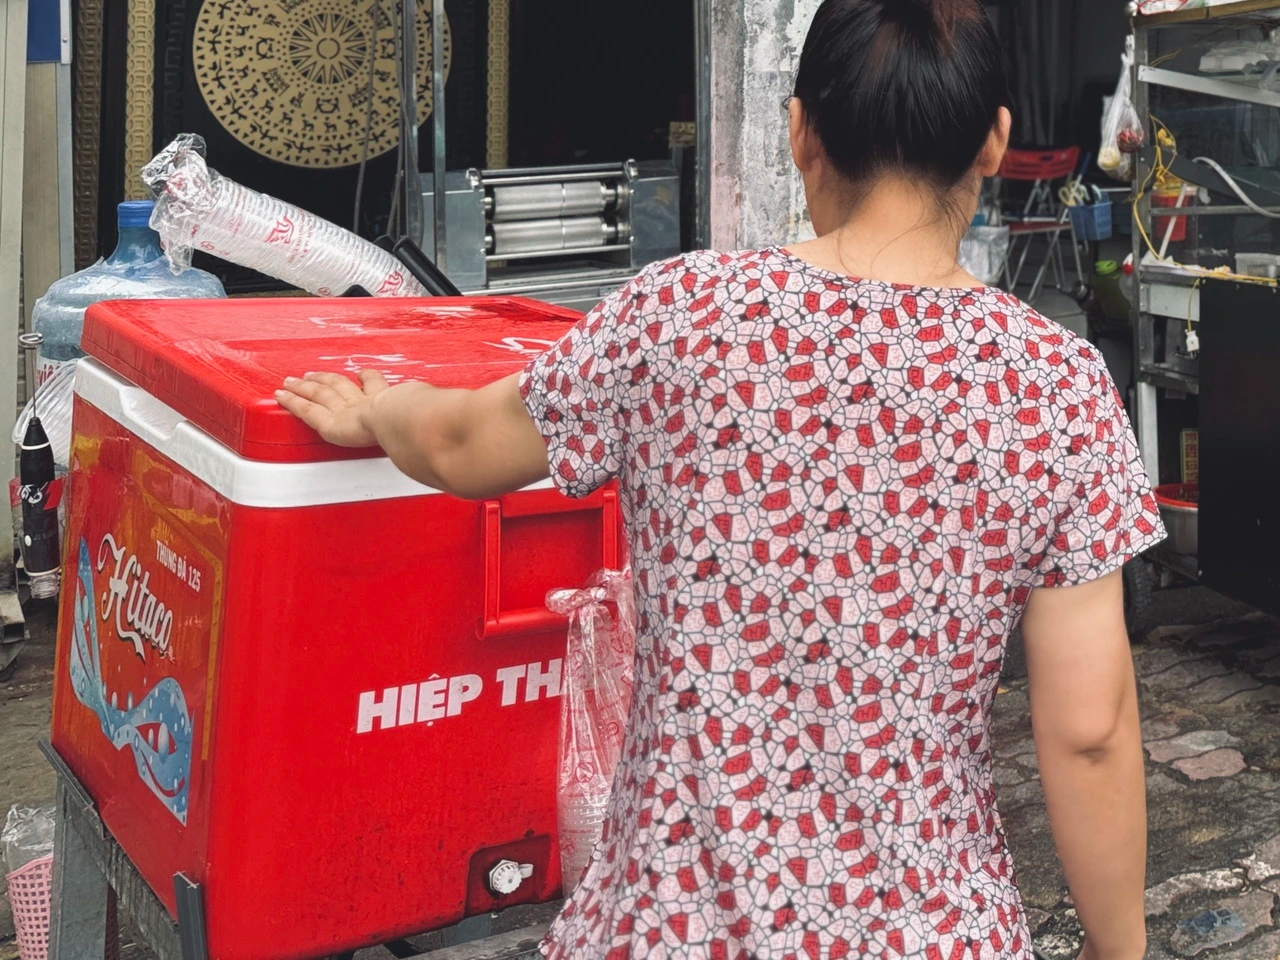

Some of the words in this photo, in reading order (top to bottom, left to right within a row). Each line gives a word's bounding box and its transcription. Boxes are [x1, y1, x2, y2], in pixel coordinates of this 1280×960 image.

[156, 539, 178, 575] THÙNG
[177, 554, 187, 582] ĐÁ
[188, 565, 202, 593] 125
[355, 671, 483, 738] HIỆP
